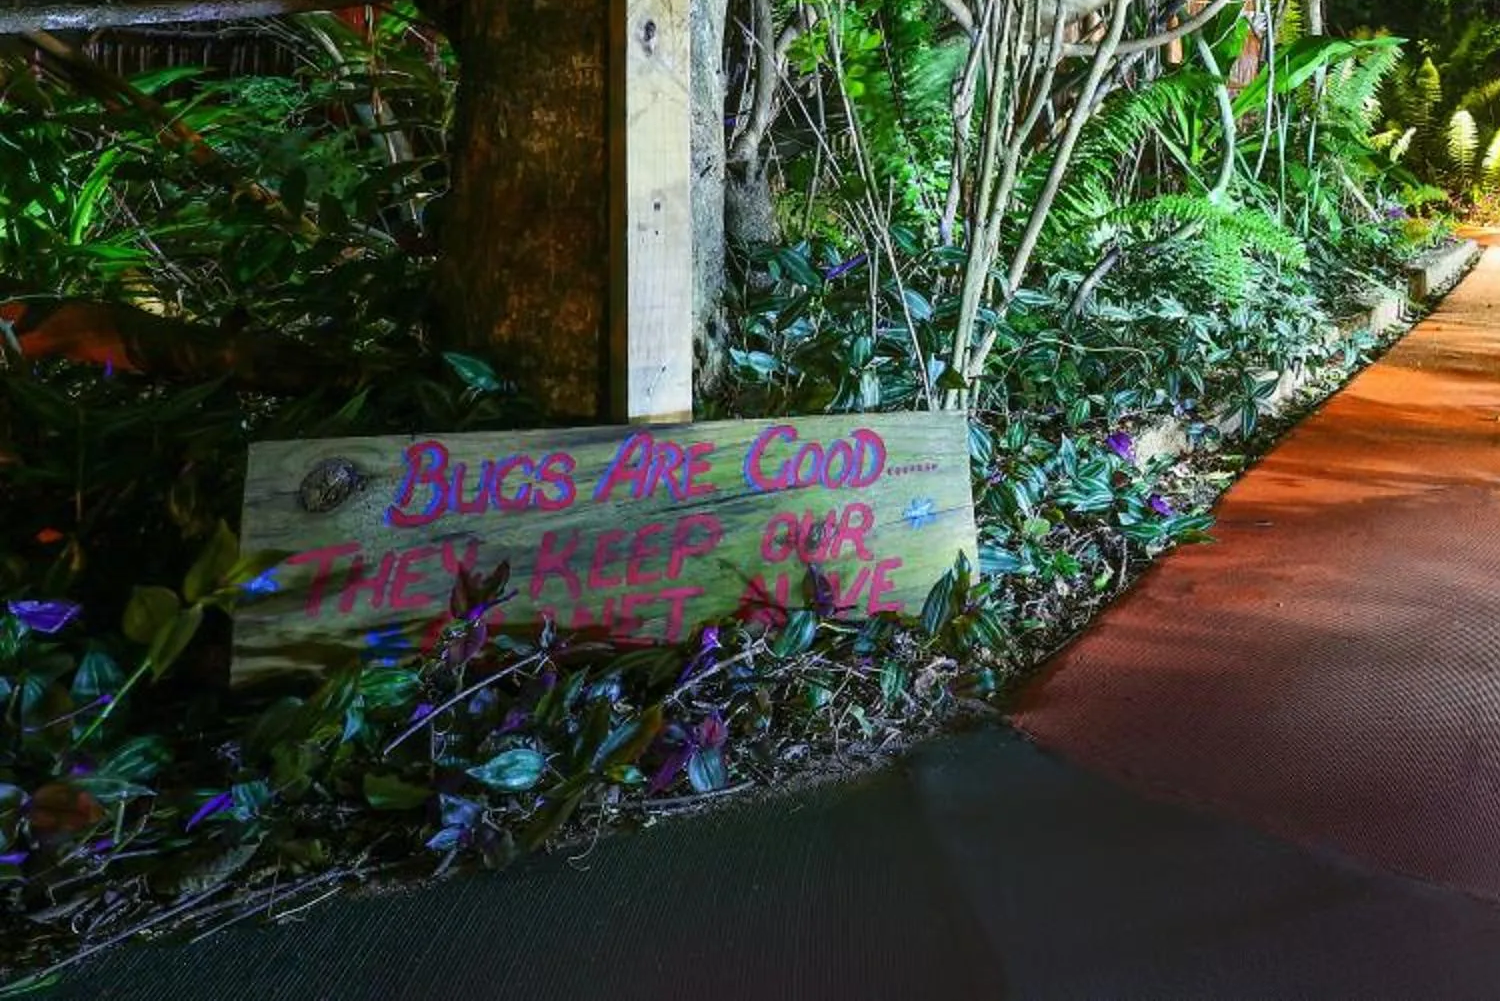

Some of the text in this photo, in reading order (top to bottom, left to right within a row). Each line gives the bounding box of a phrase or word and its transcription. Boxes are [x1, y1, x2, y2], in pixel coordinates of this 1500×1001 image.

[383, 438, 577, 528] BUGS
[591, 429, 716, 503] ARE
[528, 511, 724, 601] KEEP
[760, 502, 875, 563] OUR
